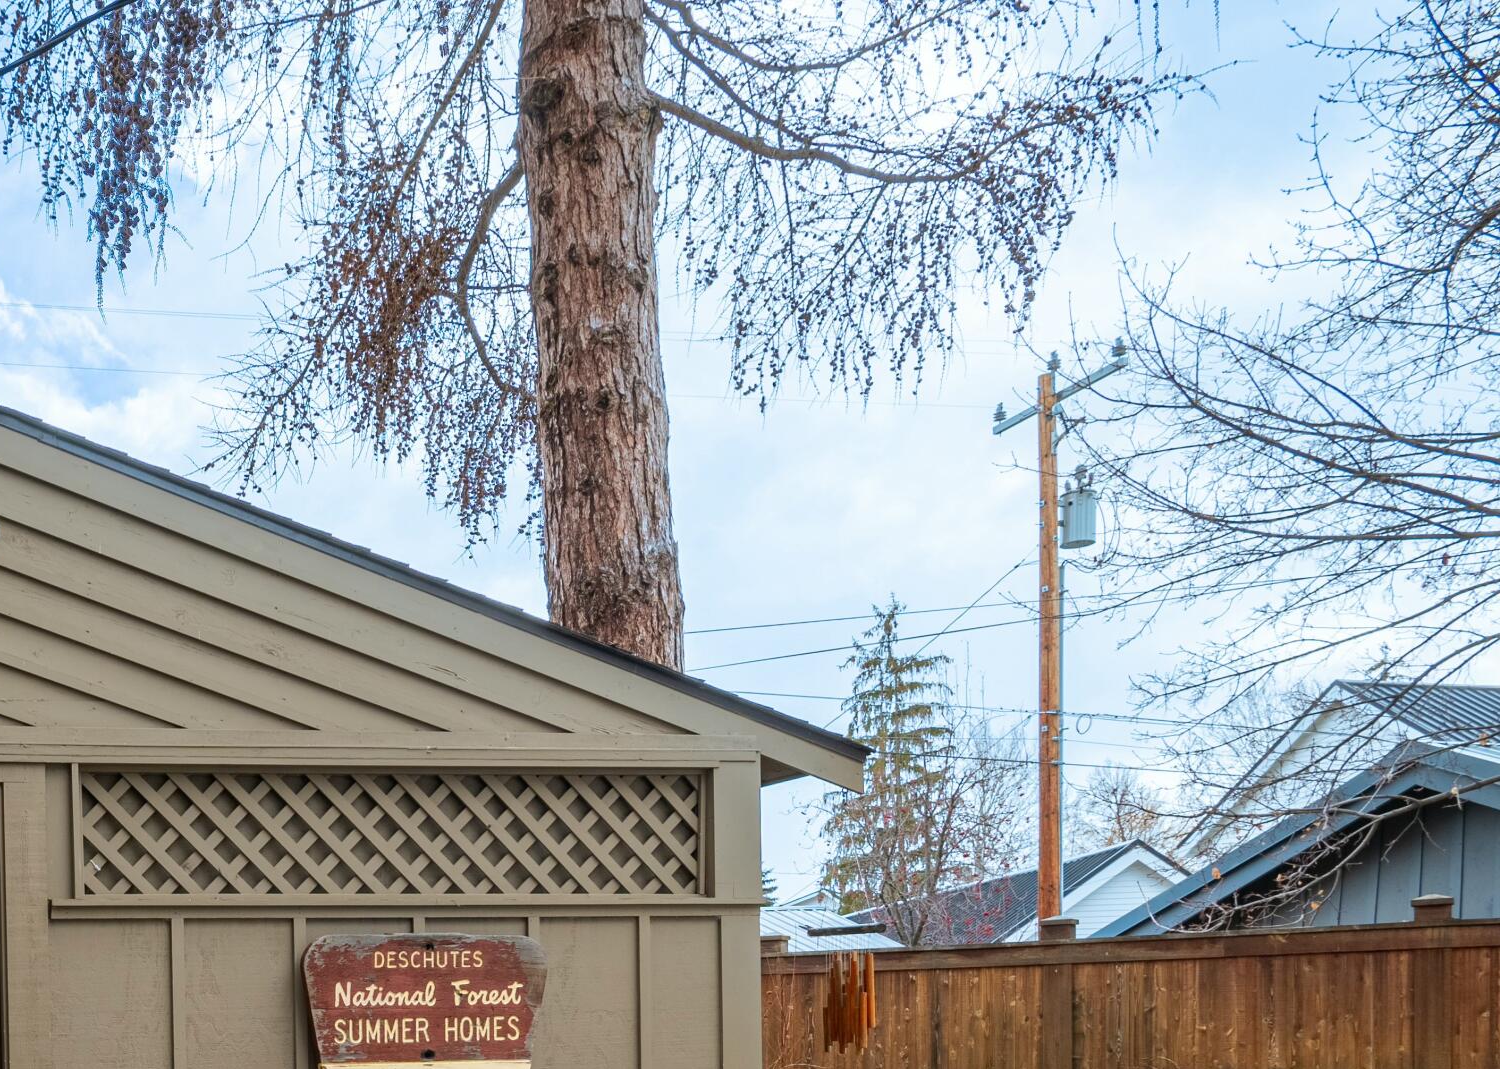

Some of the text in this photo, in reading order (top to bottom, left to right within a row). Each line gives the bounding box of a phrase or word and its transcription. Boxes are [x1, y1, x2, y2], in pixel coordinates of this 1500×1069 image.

[374, 951, 483, 968] DESCHUTES
[334, 980, 523, 1007] National Forest
[334, 1016, 520, 1044] SUMMER HOMES
